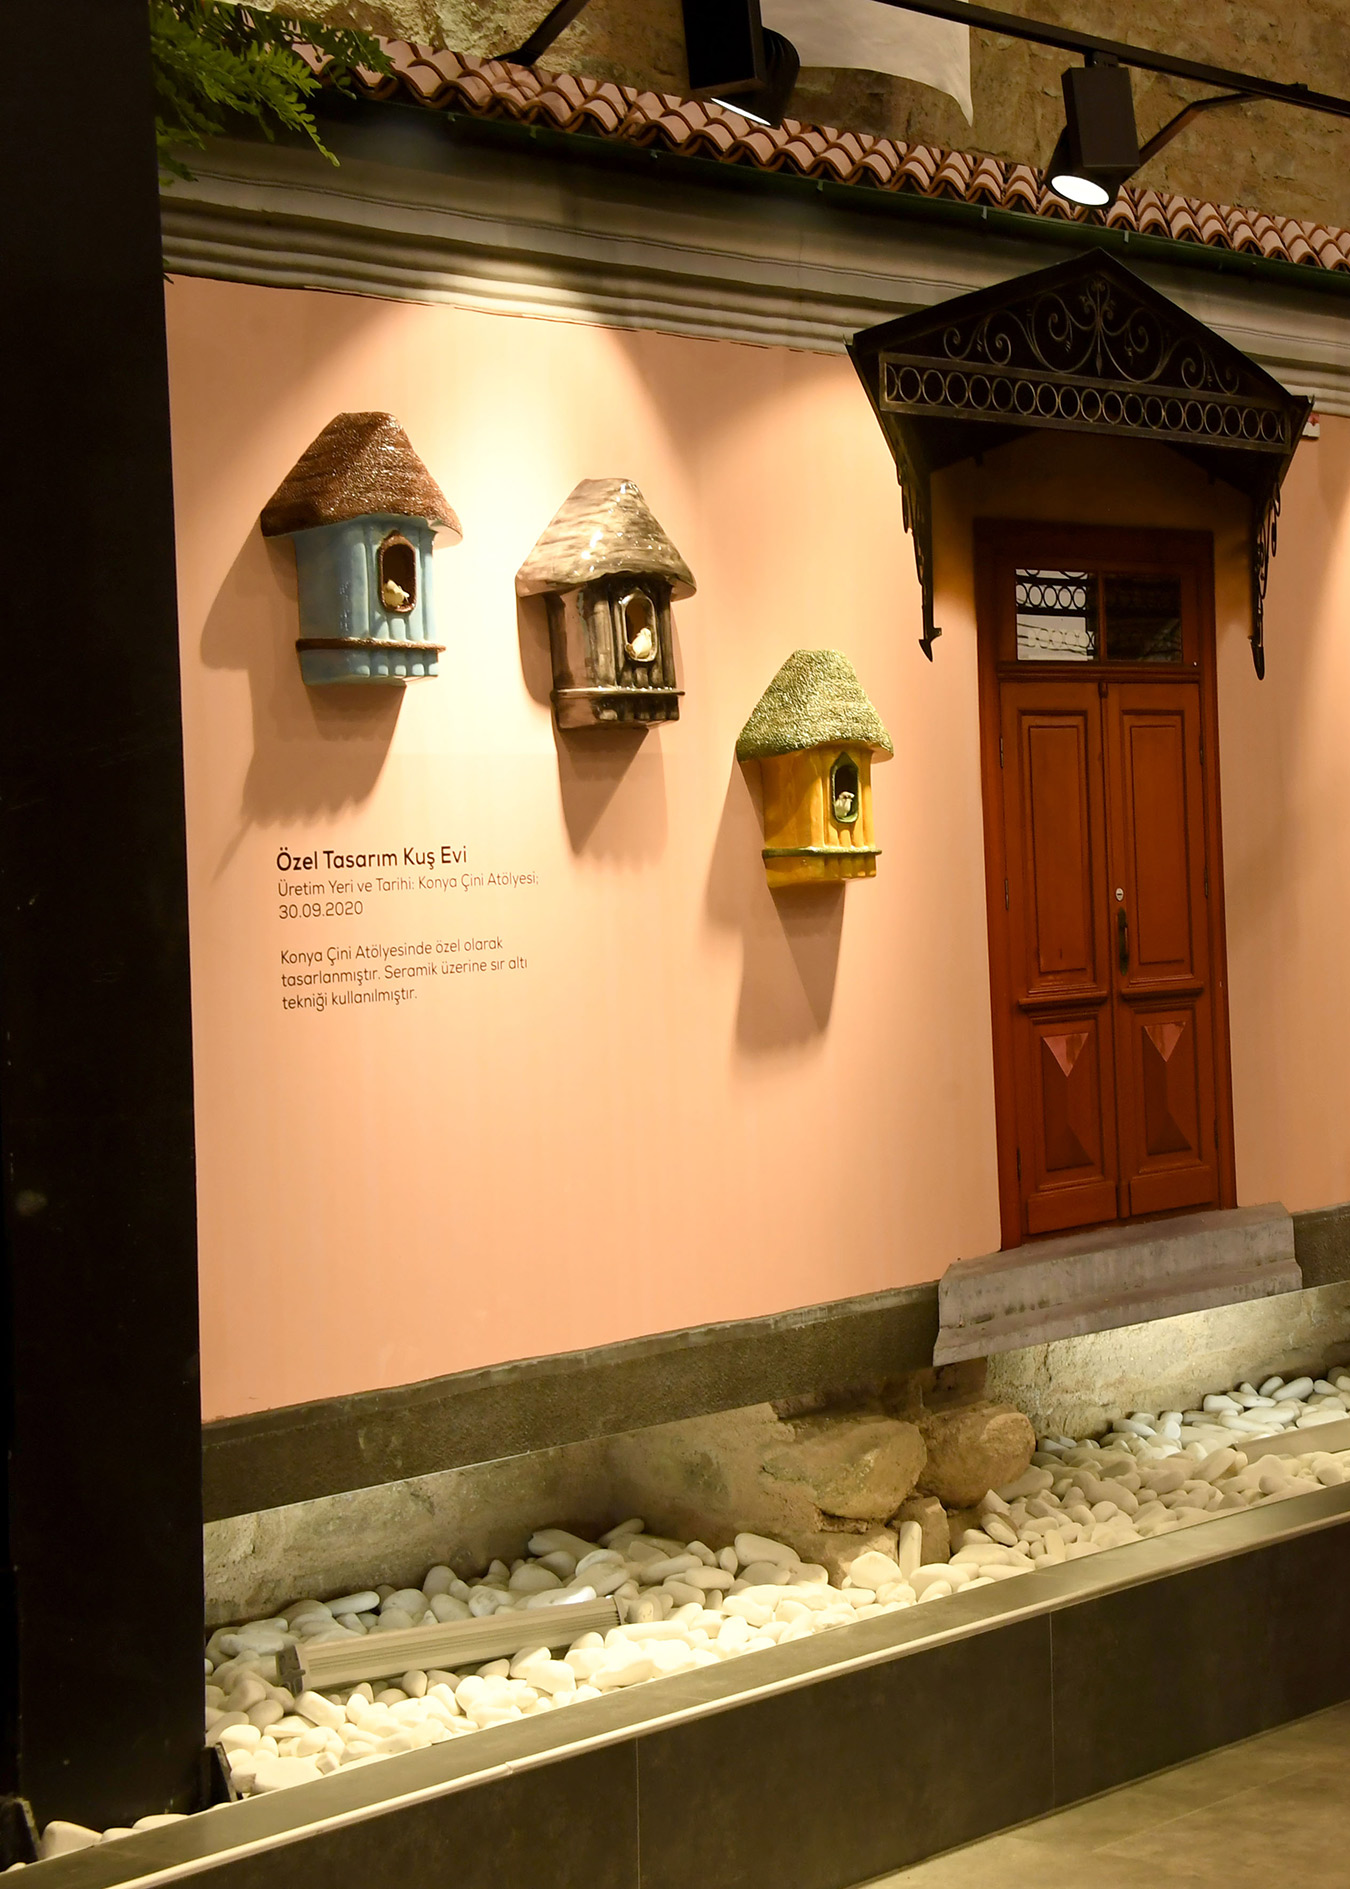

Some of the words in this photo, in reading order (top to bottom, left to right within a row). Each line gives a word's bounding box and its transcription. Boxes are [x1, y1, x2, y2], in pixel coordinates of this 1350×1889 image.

[276, 847, 318, 871] Özel
[323, 850, 397, 869] Tasarım
[403, 848, 435, 869] Kuş
[441, 845, 468, 864] Evi
[278, 879, 325, 897] Üretim
[328, 879, 354, 894] Yeri
[357, 882, 372, 892] ve
[376, 877, 414, 891] Tarihi:
[418, 875, 457, 893] Konya
[461, 873, 484, 893] Çini
[279, 901, 364, 919] 30.09.2020
[281, 950, 323, 967] Konya
[327, 946, 352, 966] Çini
[355, 941, 432, 961] Atölyesinde
[436, 939, 460, 953] özel
[463, 936, 503, 952] olarak
[281, 970, 381, 987] tasarlanmıştır.
[384, 963, 438, 979] Seramik
[441, 960, 487, 974] üzerine
[490, 960, 505, 971] sır
[508, 956, 528, 969] altı
[282, 992, 328, 1012] tekniği
[331, 987, 417, 1006] kullanılmıştır.
